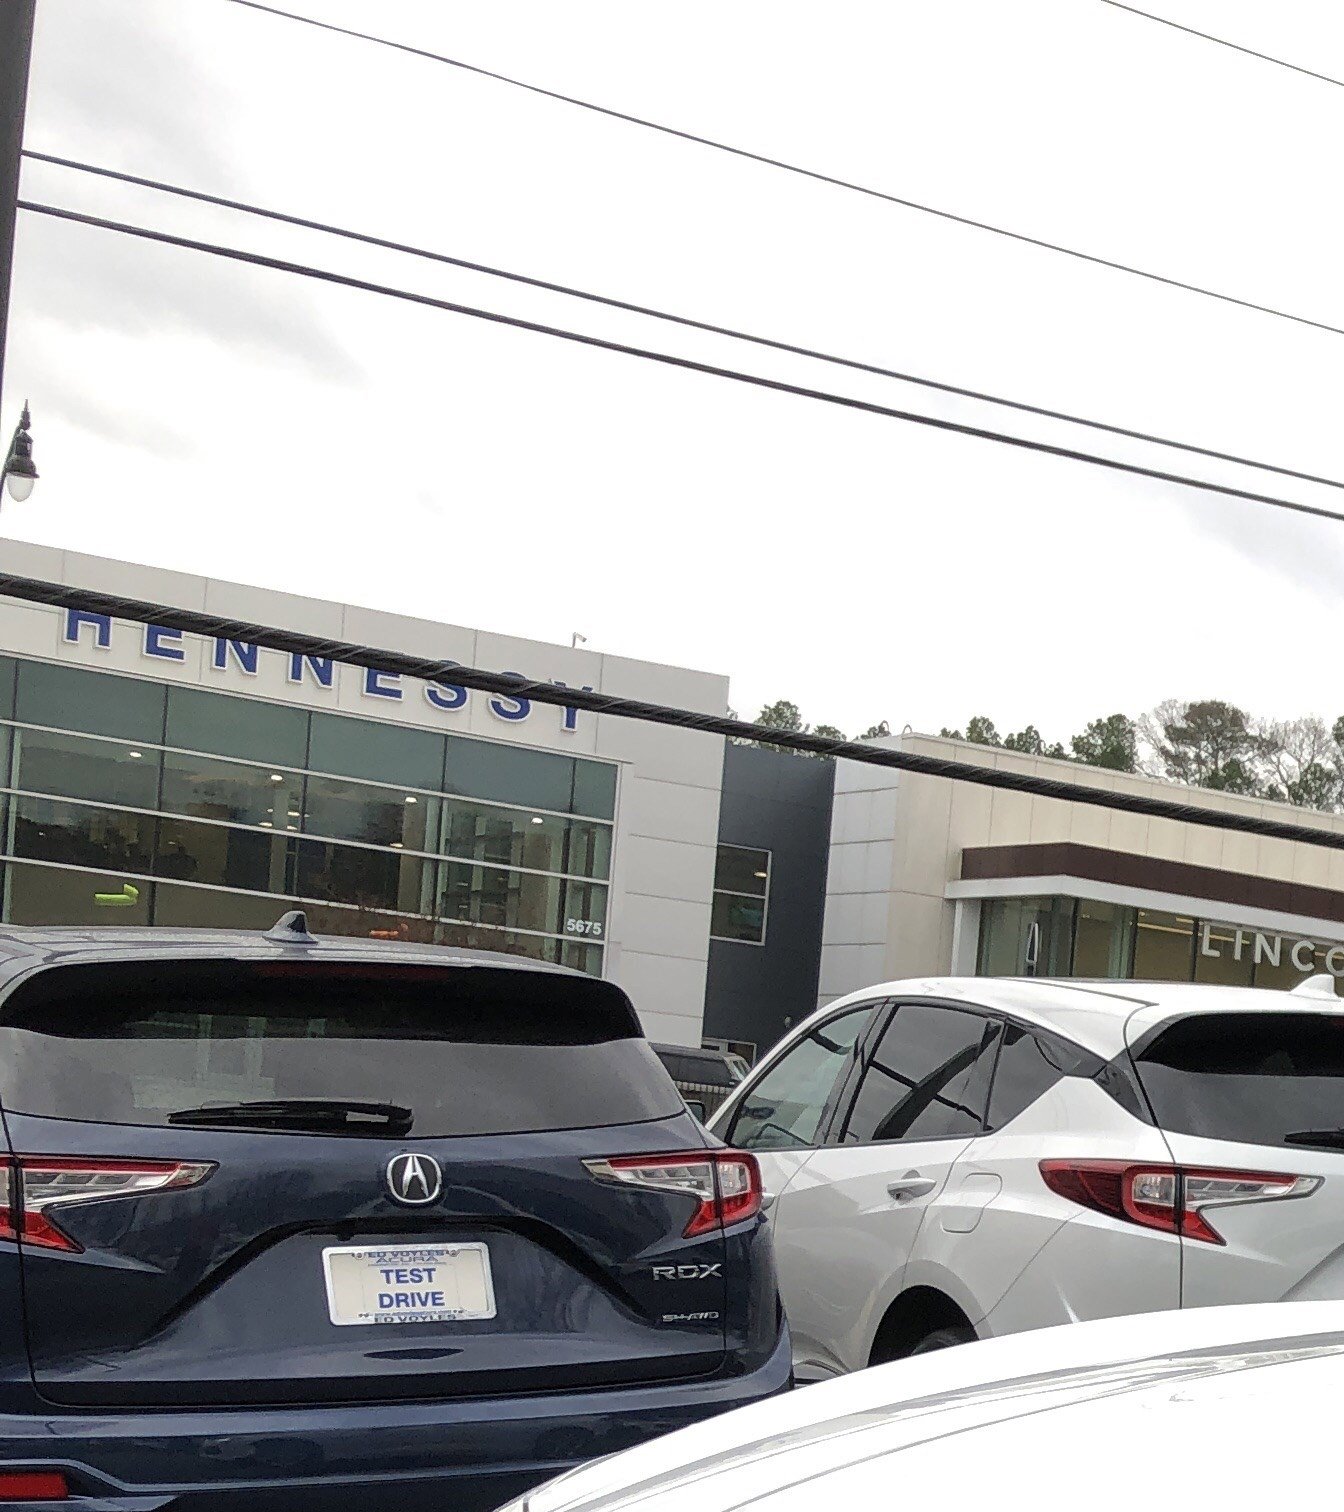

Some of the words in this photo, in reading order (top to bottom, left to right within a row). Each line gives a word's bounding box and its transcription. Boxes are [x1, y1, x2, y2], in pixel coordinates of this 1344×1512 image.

[63, 606, 594, 732] HENNESSY
[566, 918, 602, 935] 5675
[380, 1268, 436, 1284] TEST
[652, 1263, 722, 1280] RDX
[378, 1291, 446, 1309] DRIVE
